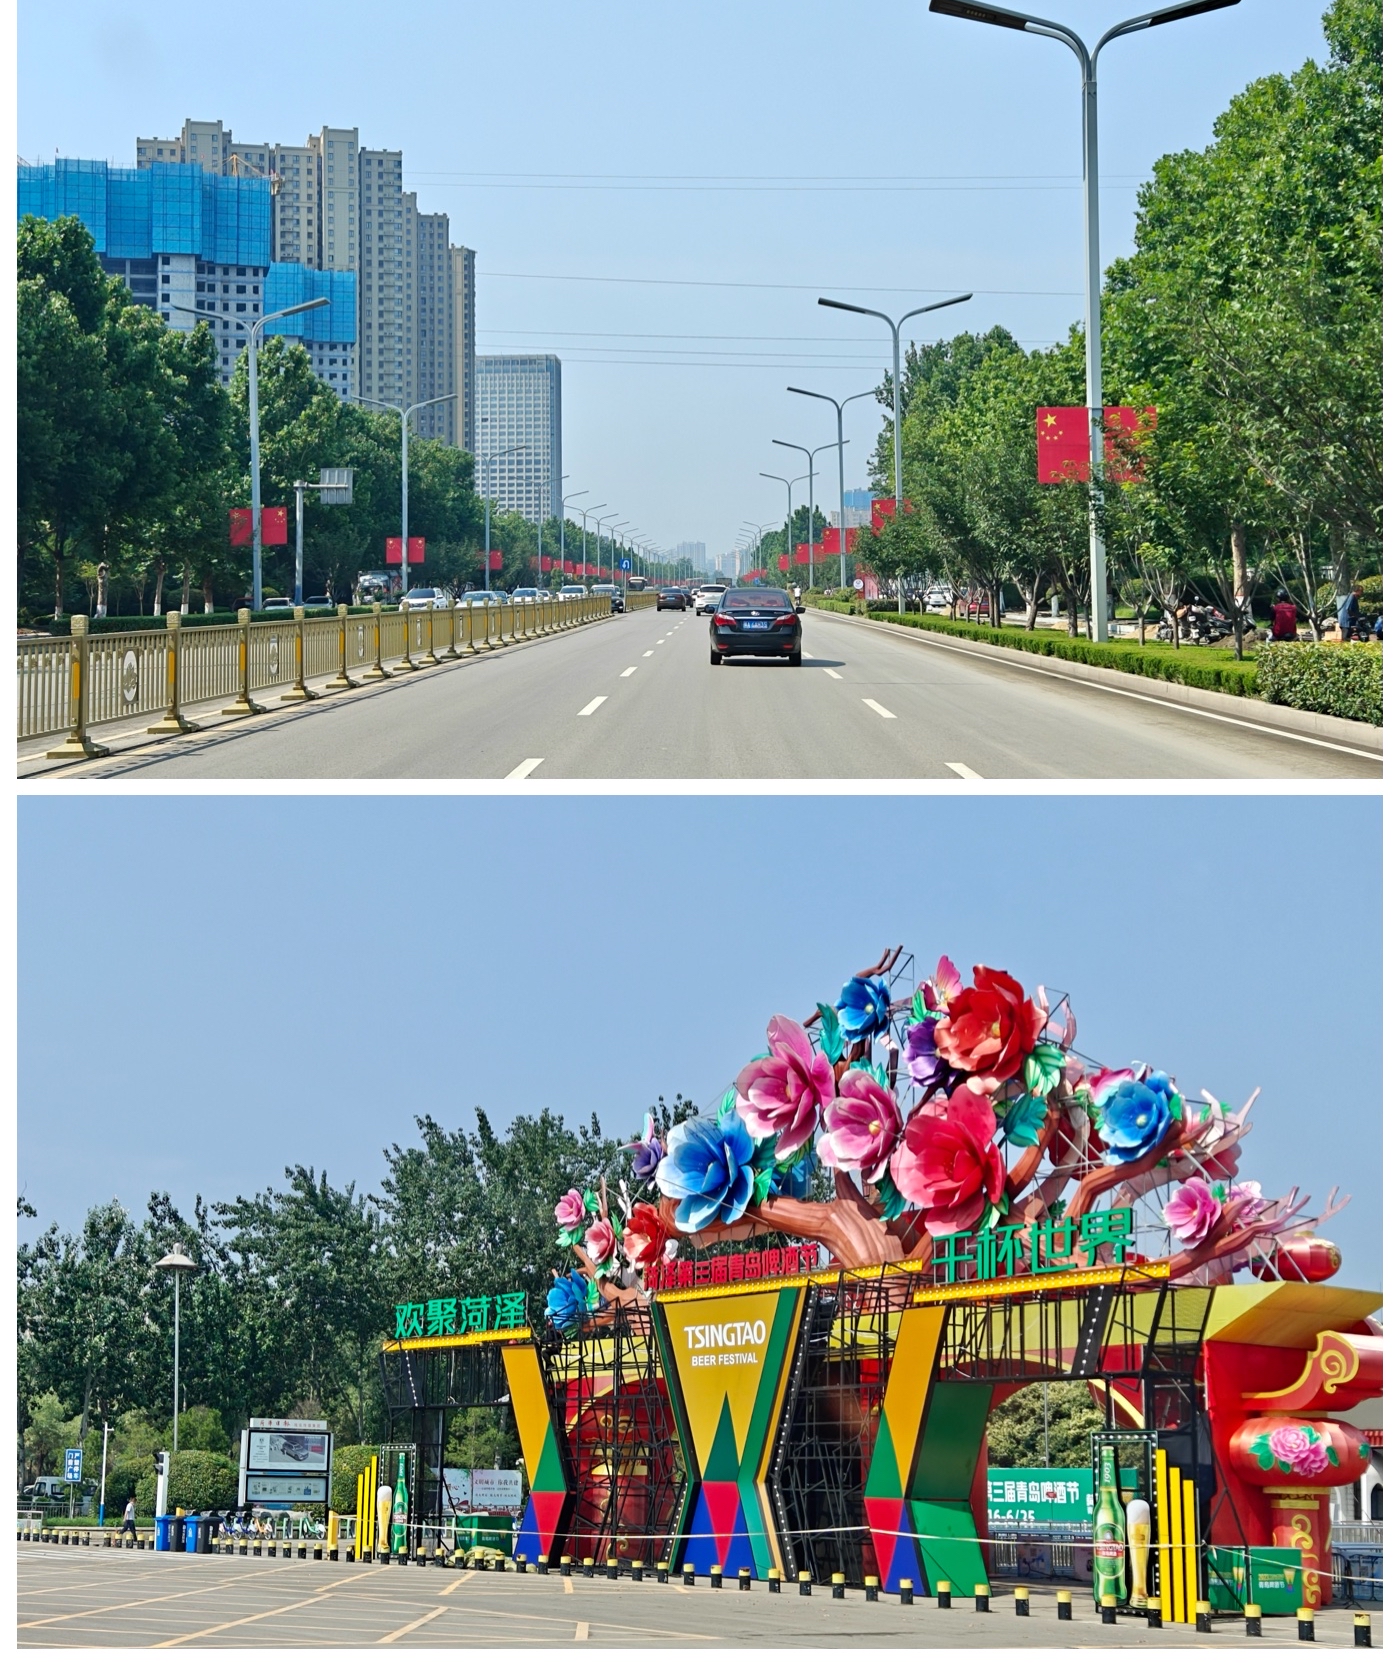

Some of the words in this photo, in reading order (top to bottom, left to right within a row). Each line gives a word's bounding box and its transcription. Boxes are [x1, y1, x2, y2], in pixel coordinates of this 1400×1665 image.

[643, 1244, 819, 1291] 菏泽第三届青岛啤酒节
[394, 1291, 526, 1339] 欢聚菏泽
[683, 1319, 766, 1349] TSINGTAO
[691, 1355, 716, 1367] BEER
[718, 1352, 758, 1365] FESTIVAL
[1103, 1462, 1112, 1483] 1903
